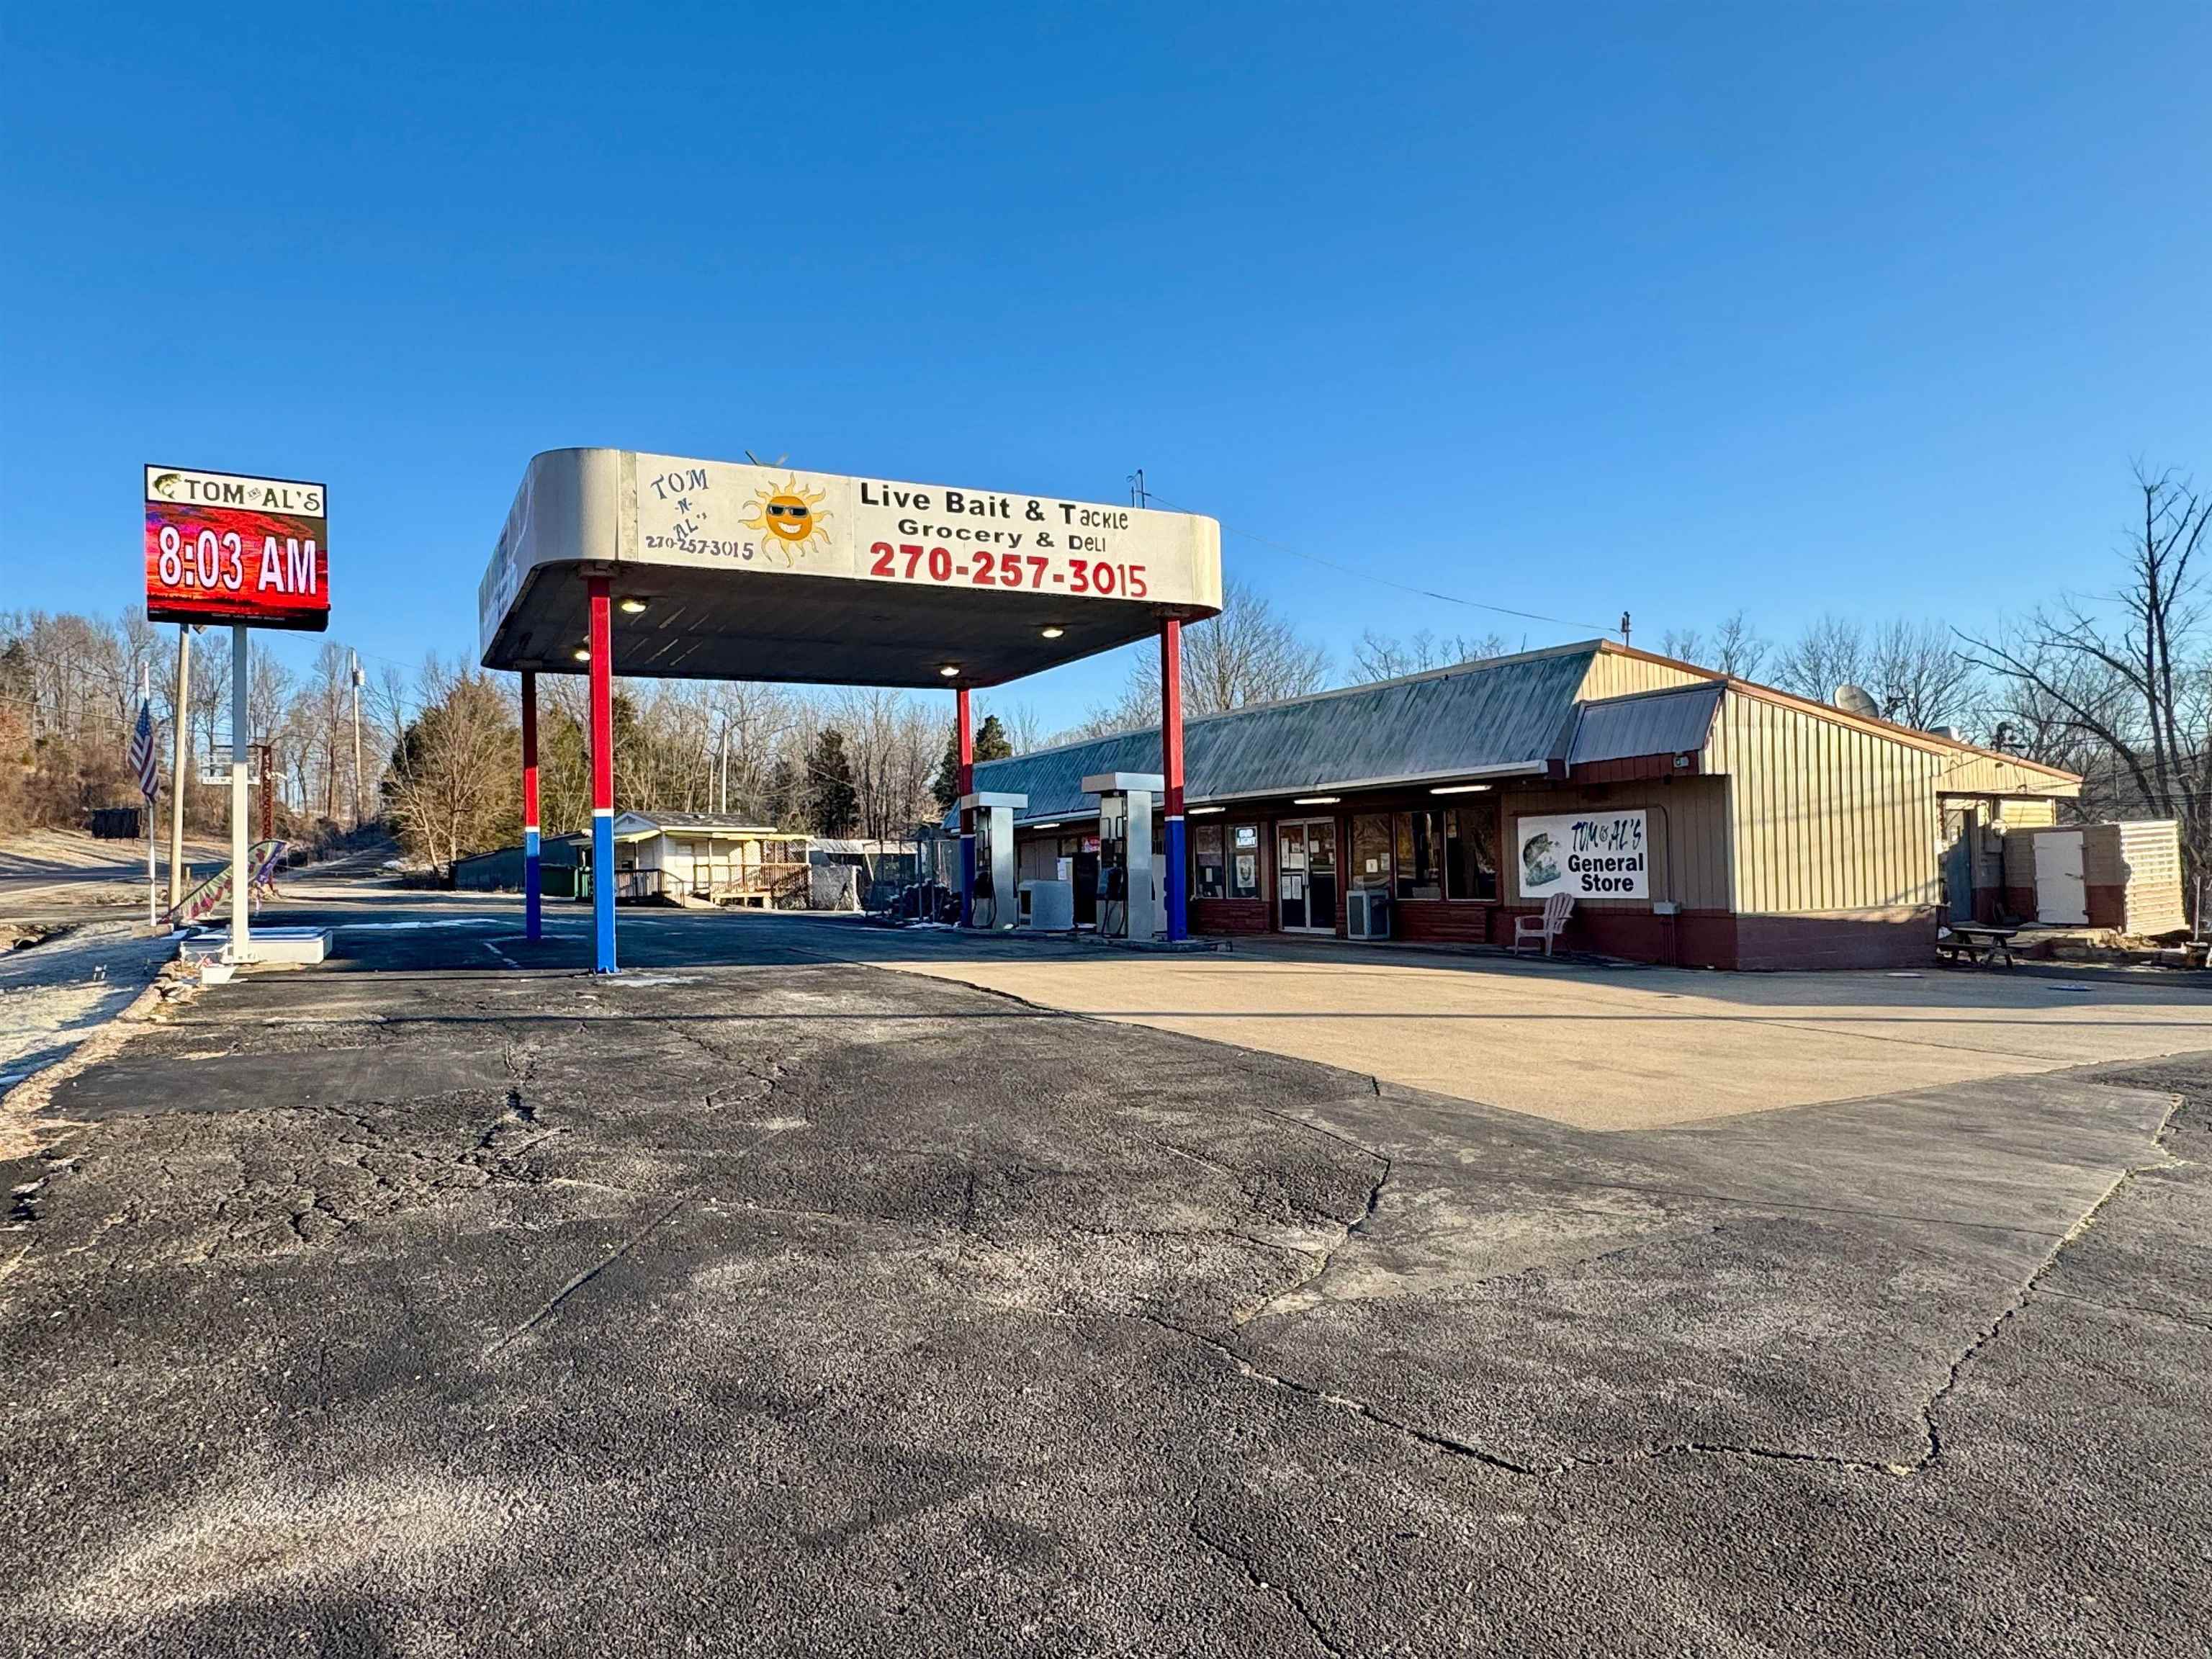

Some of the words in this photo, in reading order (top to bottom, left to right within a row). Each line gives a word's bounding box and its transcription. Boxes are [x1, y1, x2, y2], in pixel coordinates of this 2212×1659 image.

[184, 478, 246, 505] TOM
[262, 487, 320, 511] AL'S
[650, 469, 709, 500] TOM
[860, 482, 930, 511] Live
[945, 491, 1011, 518] Bait
[1025, 500, 1046, 521] &
[646, 536, 754, 560] 270-257-3015
[898, 518, 1023, 549] Grocery
[1036, 532, 1055, 547] &
[158, 526, 243, 590] 8:03
[257, 535, 318, 595] AM
[870, 541, 1148, 598] 270-257-3015
[1568, 853, 1644, 872] General
[1581, 873, 1634, 891] Store
